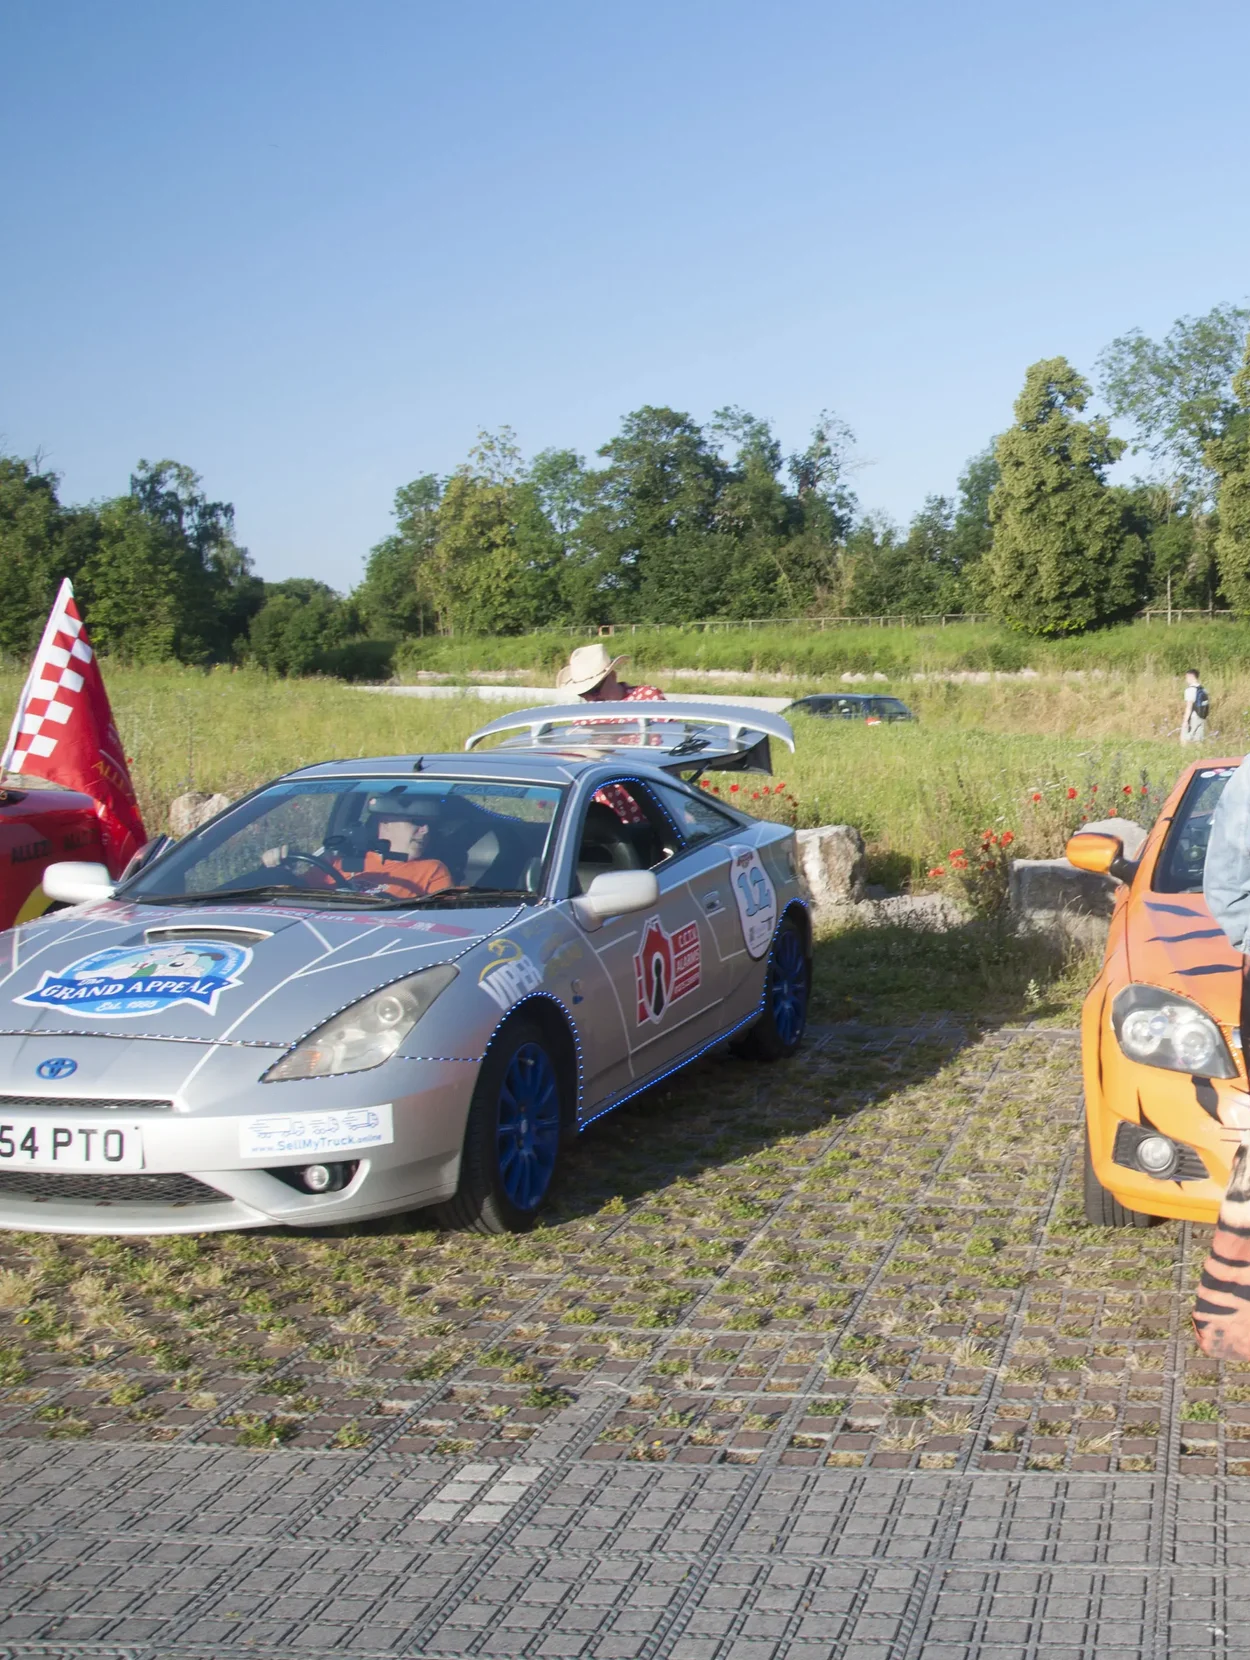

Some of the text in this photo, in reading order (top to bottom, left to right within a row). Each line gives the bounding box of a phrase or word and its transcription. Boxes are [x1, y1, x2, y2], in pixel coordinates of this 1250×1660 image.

[40, 980, 215, 1000] GRAND APPEAL
[477, 954, 544, 1011] VIPER
[52, 1127, 125, 1162] PTO
